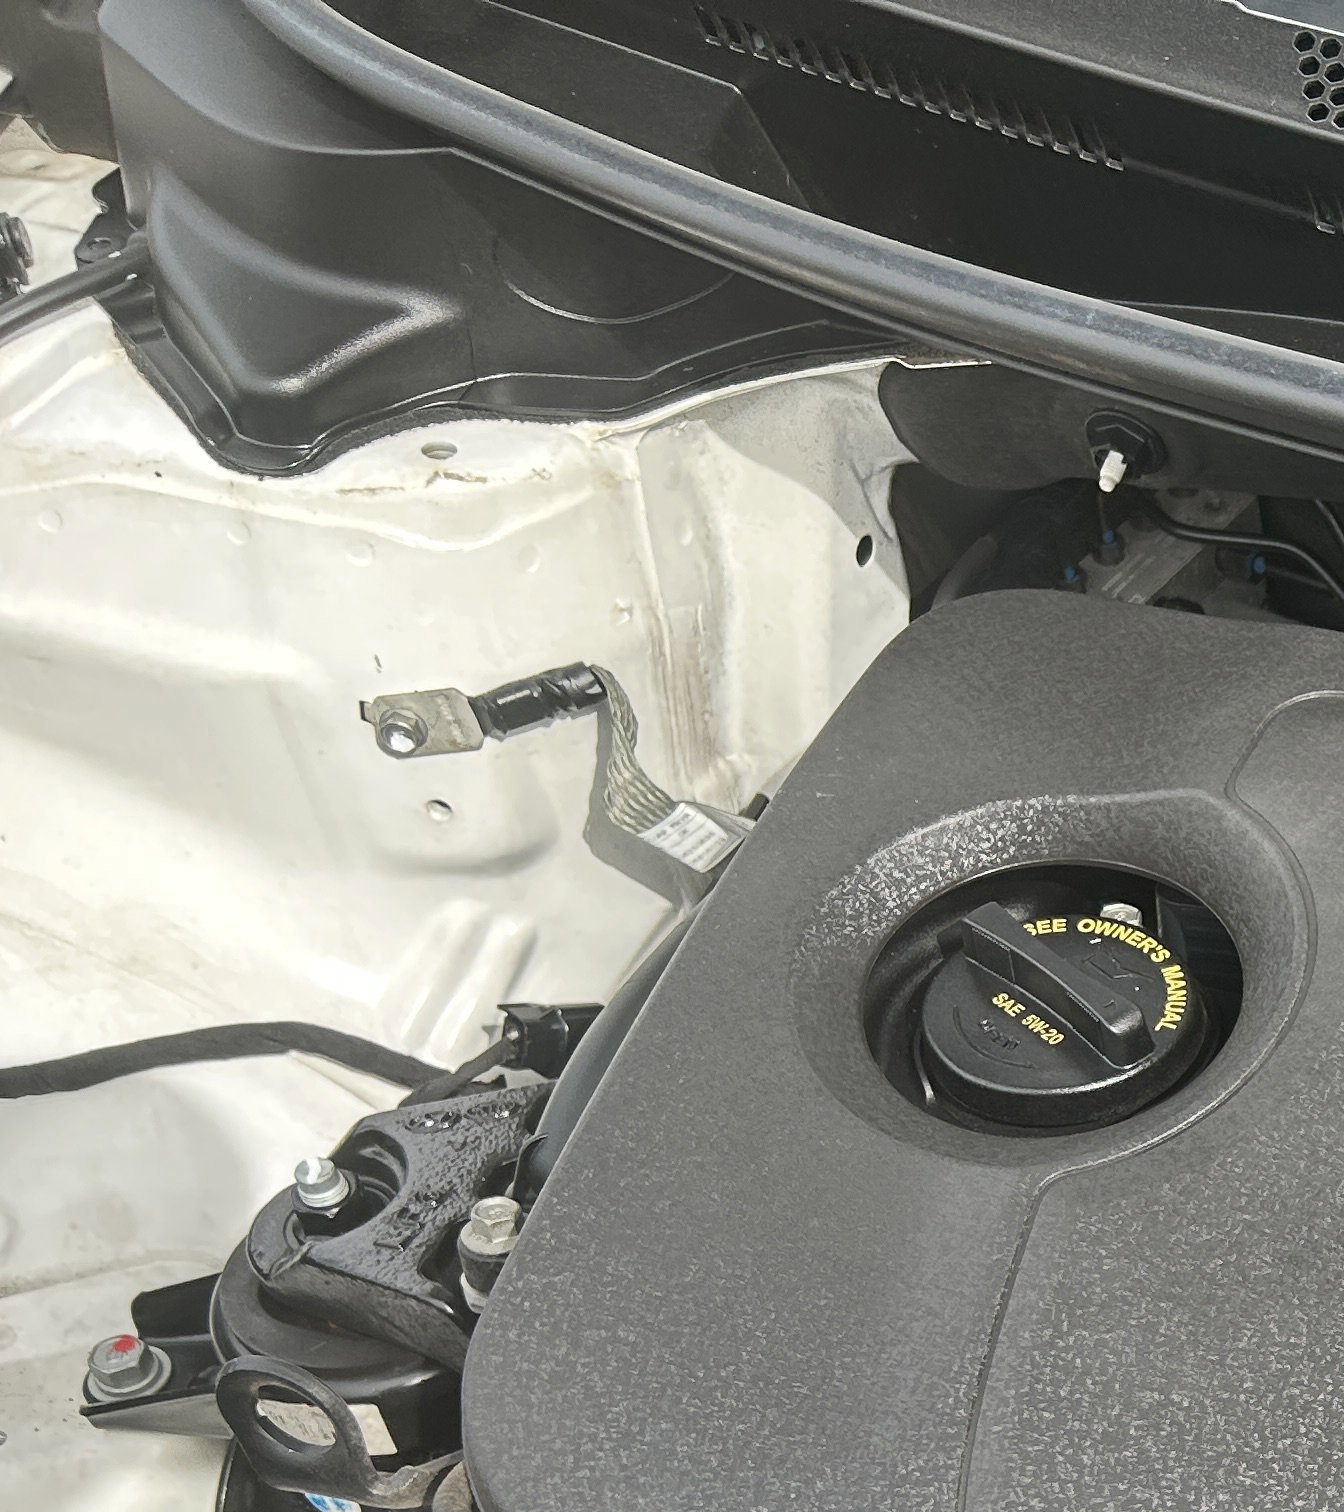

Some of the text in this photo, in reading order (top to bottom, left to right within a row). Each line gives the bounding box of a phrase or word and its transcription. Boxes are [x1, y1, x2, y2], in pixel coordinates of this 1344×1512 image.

[1077, 918, 1171, 963] OWNER'S
[1154, 964, 1188, 1032] MANUAL
[991, 992, 1026, 1018] SAE
[1021, 1013, 1066, 1047] 5W-20
